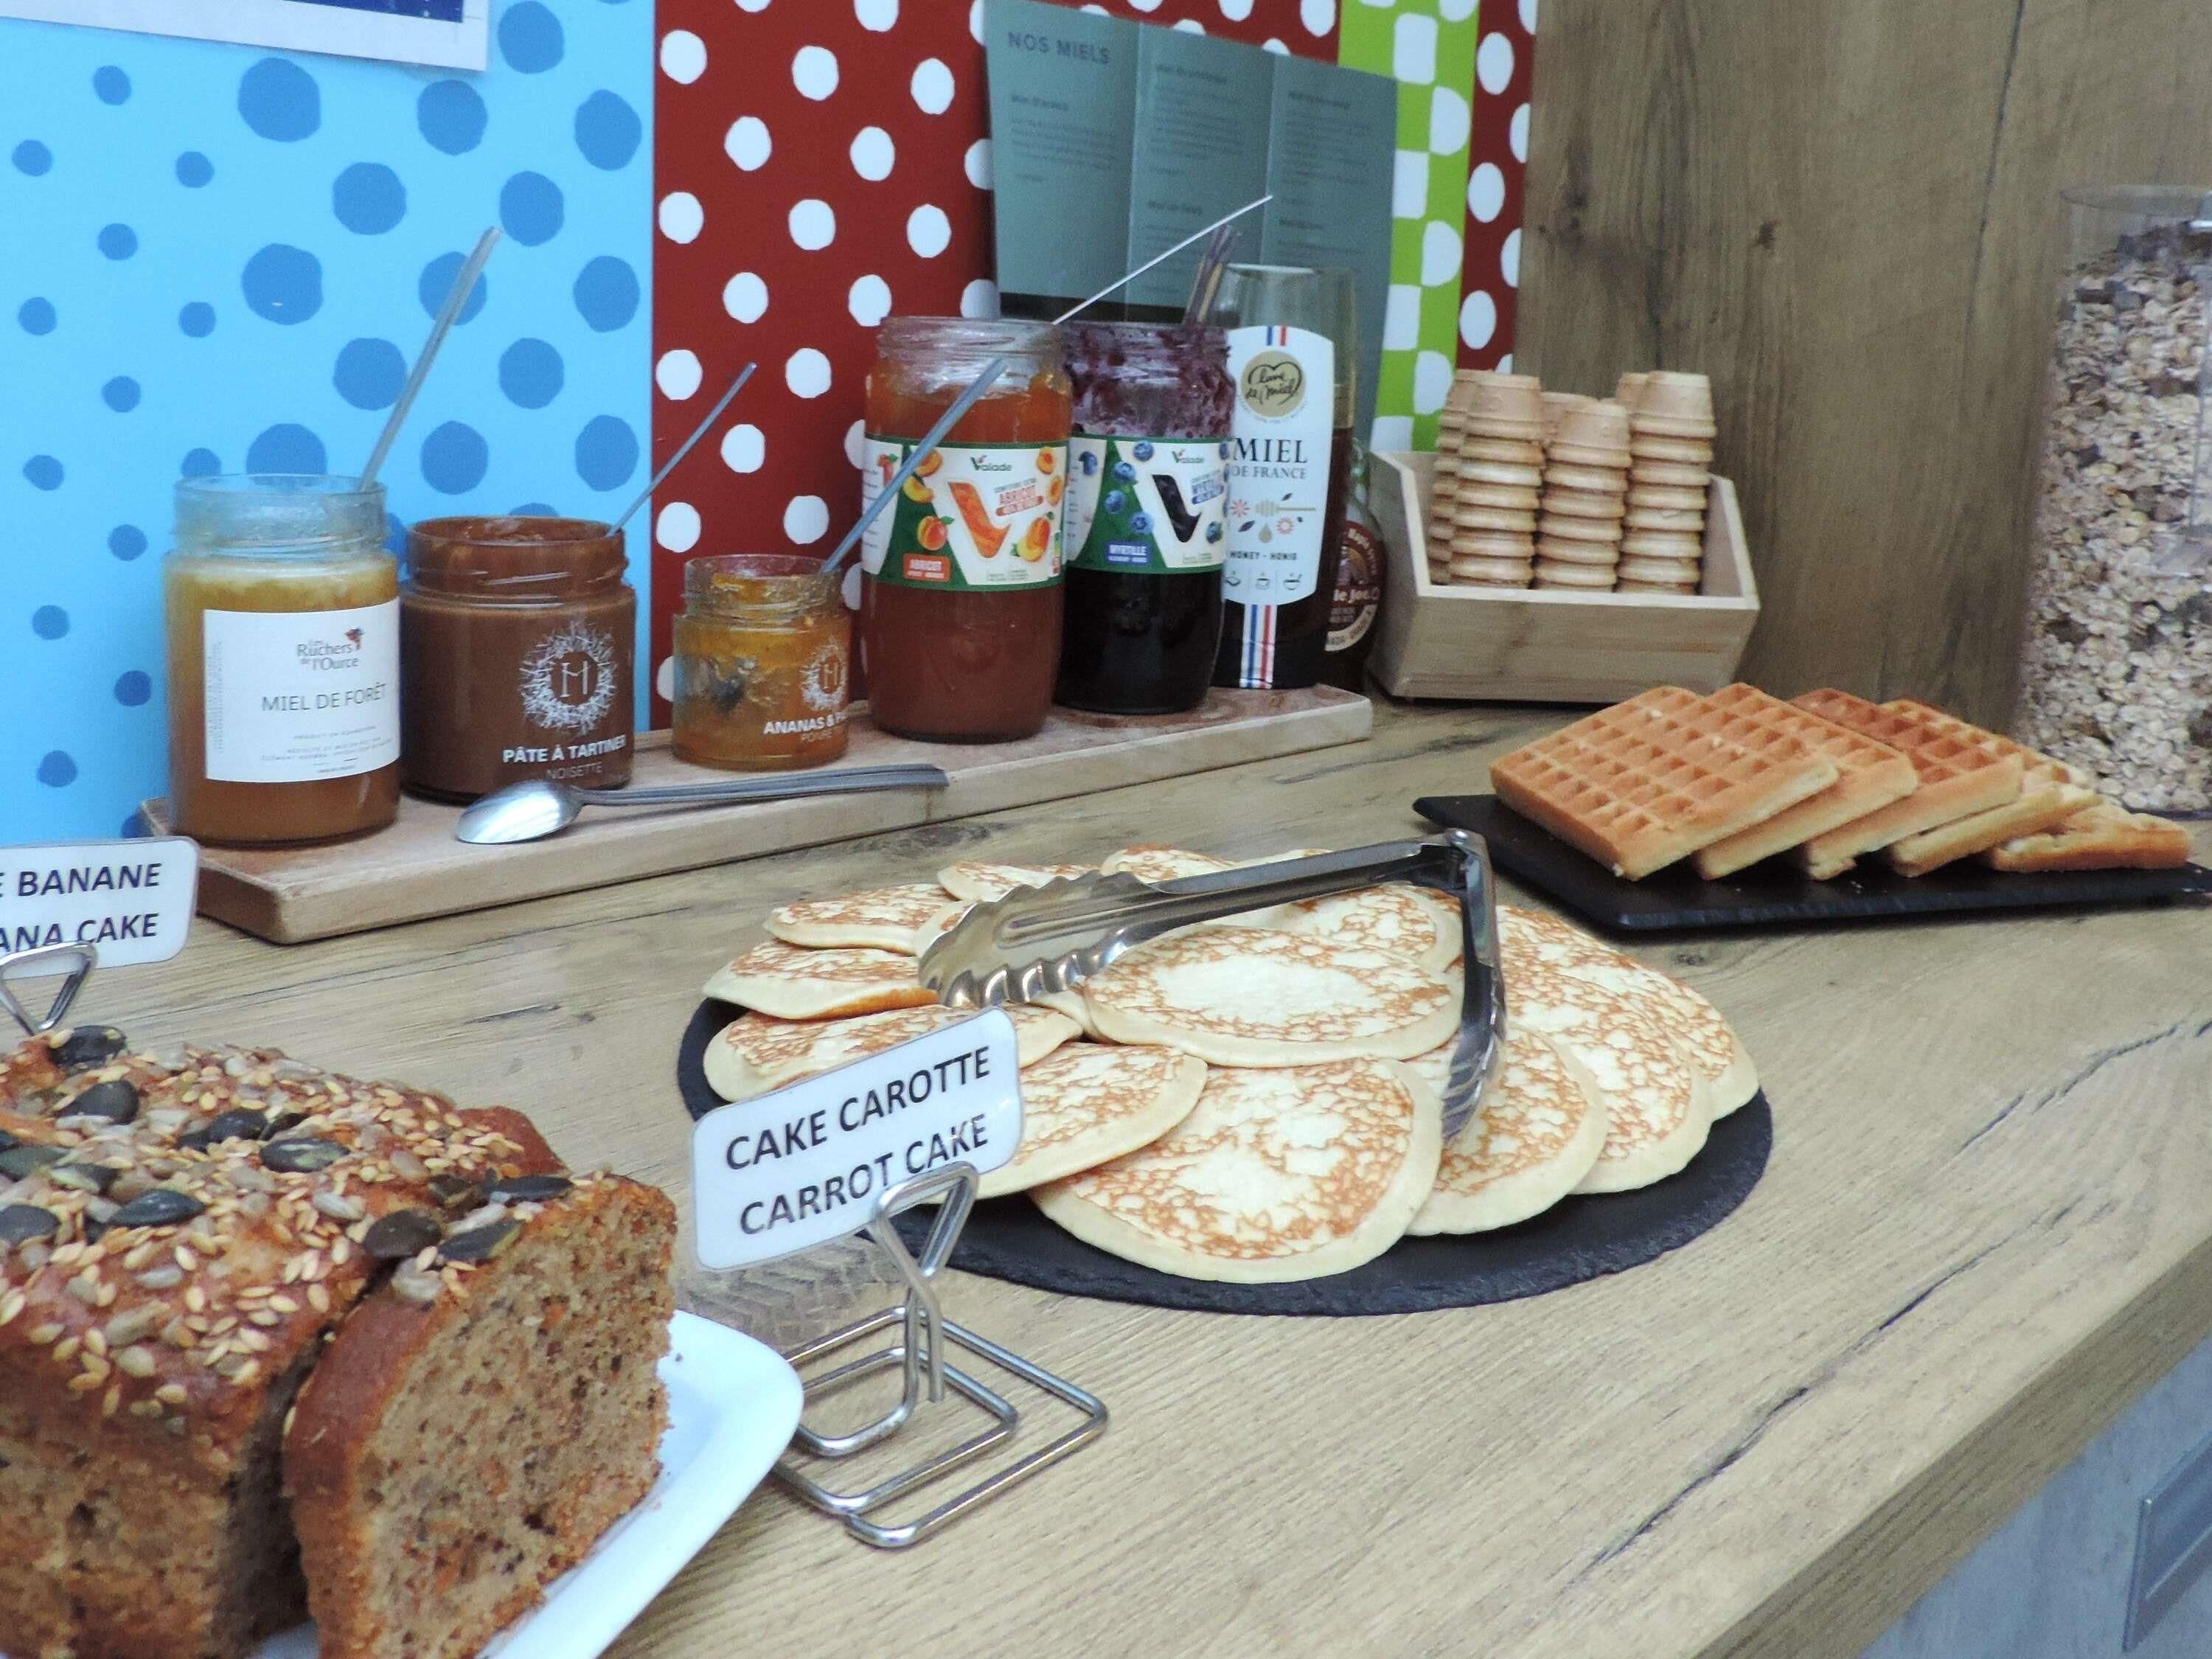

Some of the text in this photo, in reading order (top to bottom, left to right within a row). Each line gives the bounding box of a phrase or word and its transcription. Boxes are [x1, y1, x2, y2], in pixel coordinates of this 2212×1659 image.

[1008, 31, 1110, 66] NOS MIELS
[1234, 437, 1308, 464] MIEL
[1253, 466, 1307, 480] FRANCE
[262, 681, 386, 712] MIEL DE FORÊT
[763, 716, 826, 735] ANANAS
[502, 745, 549, 762] PÂTE
[551, 743, 565, 761] À
[547, 762, 602, 779] NOISETTE
[18, 862, 162, 897] BANANE
[77, 913, 159, 943] CAKE
[726, 1046, 991, 1171] CAKE CAROTTE
[740, 1113, 989, 1235] CARROT CAKE
